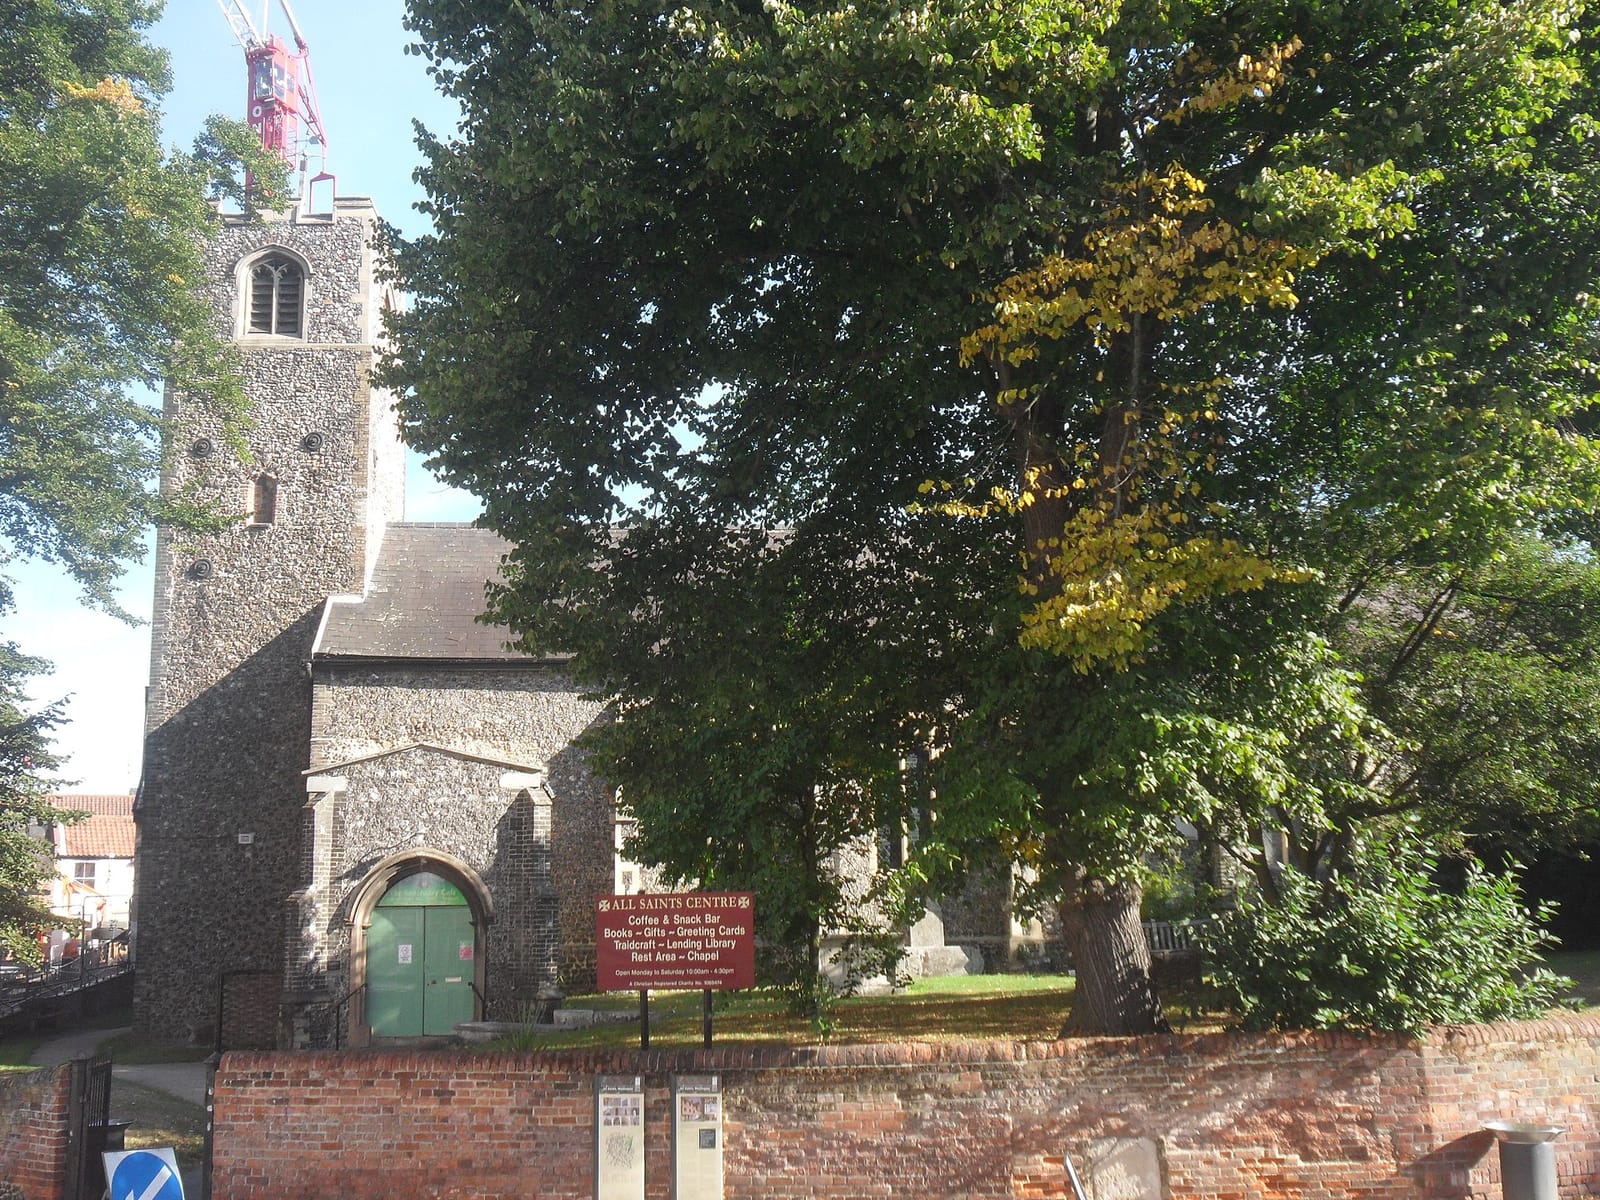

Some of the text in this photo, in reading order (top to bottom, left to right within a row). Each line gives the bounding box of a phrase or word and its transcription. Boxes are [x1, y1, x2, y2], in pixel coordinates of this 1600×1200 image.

[612, 897, 736, 910] ALL SAINTS CENTRE
[629, 914, 720, 925] Coffee & Snack Bar
[604, 928, 632, 938] Books
[644, 927, 665, 937] Gifts
[677, 927, 715, 937] Greeting
[719, 926, 745, 935] Cards
[614, 940, 655, 950] Traidcraft
[667, 939, 702, 950] Lending
[706, 939, 736, 949] Library
[632, 952, 652, 962] Rest
[656, 952, 676, 961] Area
[688, 951, 719, 962] Chapel
